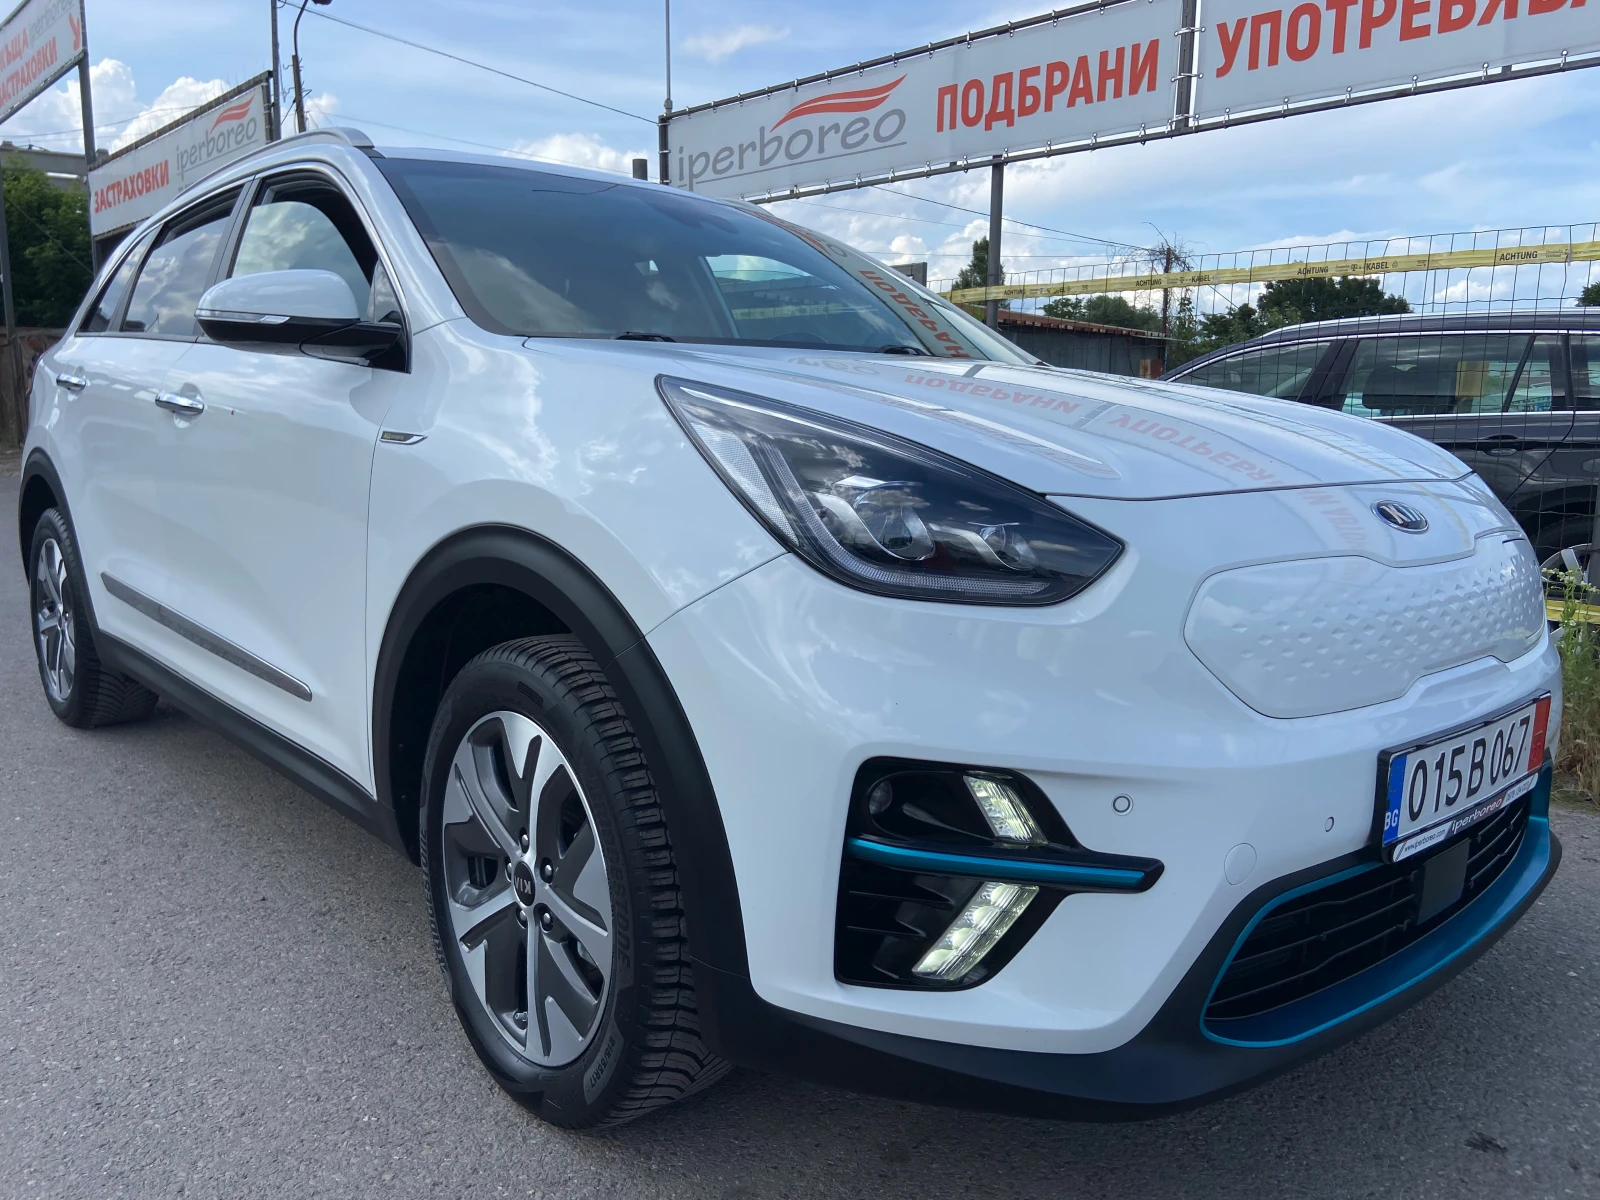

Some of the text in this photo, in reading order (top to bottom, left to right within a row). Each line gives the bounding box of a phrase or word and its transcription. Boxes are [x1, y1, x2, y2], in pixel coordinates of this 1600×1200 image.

[936, 38, 1160, 133] ПОДБРАНИ
[176, 117, 258, 181] iperboreo
[678, 108, 906, 191] iperboreo
[94, 159, 170, 214] ЗАСТРАХОВКИ
[1297, 265, 1329, 276] ACHTUNG
[1366, 261, 1390, 271] KABEL
[1499, 250, 1538, 261] ACHTUNG
[1135, 278, 1162, 287] ACHTUNG
[1408, 714, 1531, 822] 015B067
[1384, 808, 1399, 831] BG
[1451, 798, 1502, 834] iperboreo
